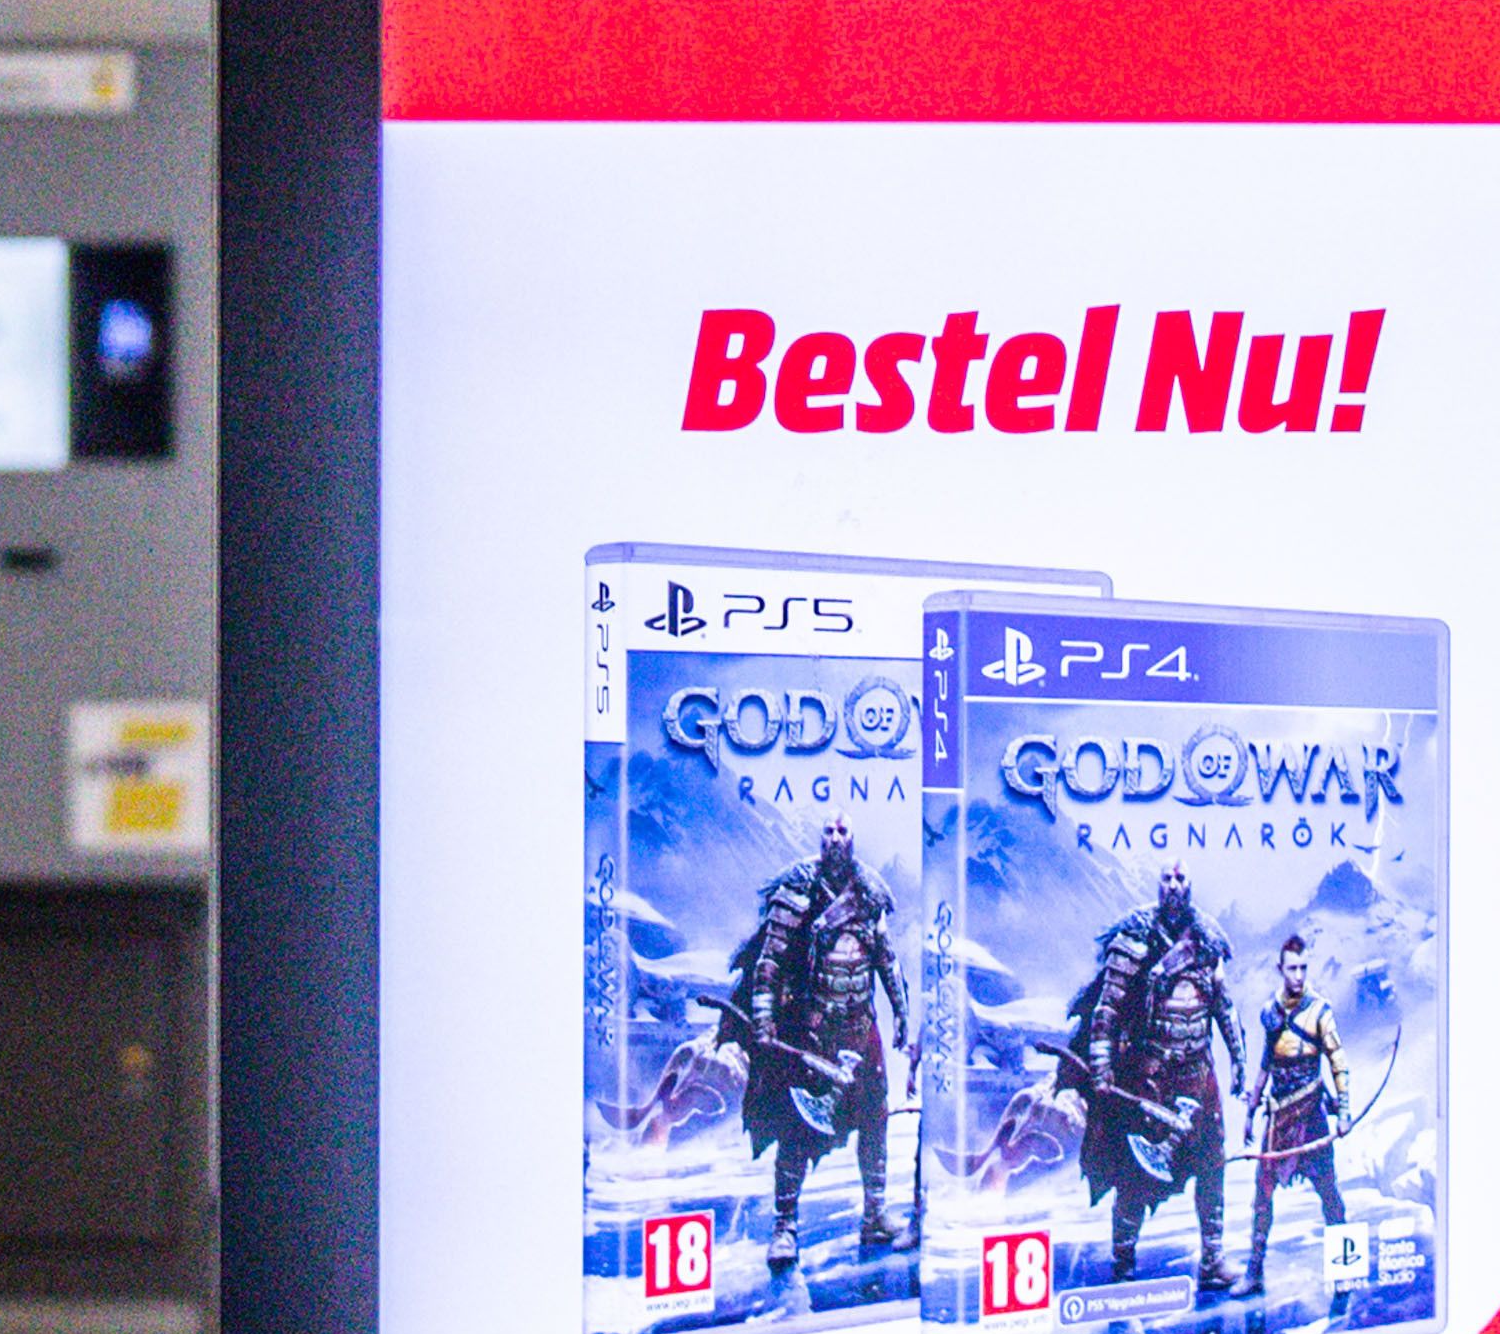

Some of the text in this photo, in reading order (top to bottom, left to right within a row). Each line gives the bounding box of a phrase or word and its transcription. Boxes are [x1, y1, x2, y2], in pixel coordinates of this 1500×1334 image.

[681, 304, 1387, 435] Bestel Nu!
[723, 593, 854, 634] PS5
[661, 684, 837, 779] GOD
[1000, 733, 1178, 825] GOD
[1248, 740, 1405, 825] WAR
[648, 1220, 709, 1290] 18
[985, 1237, 1047, 1308] 18
